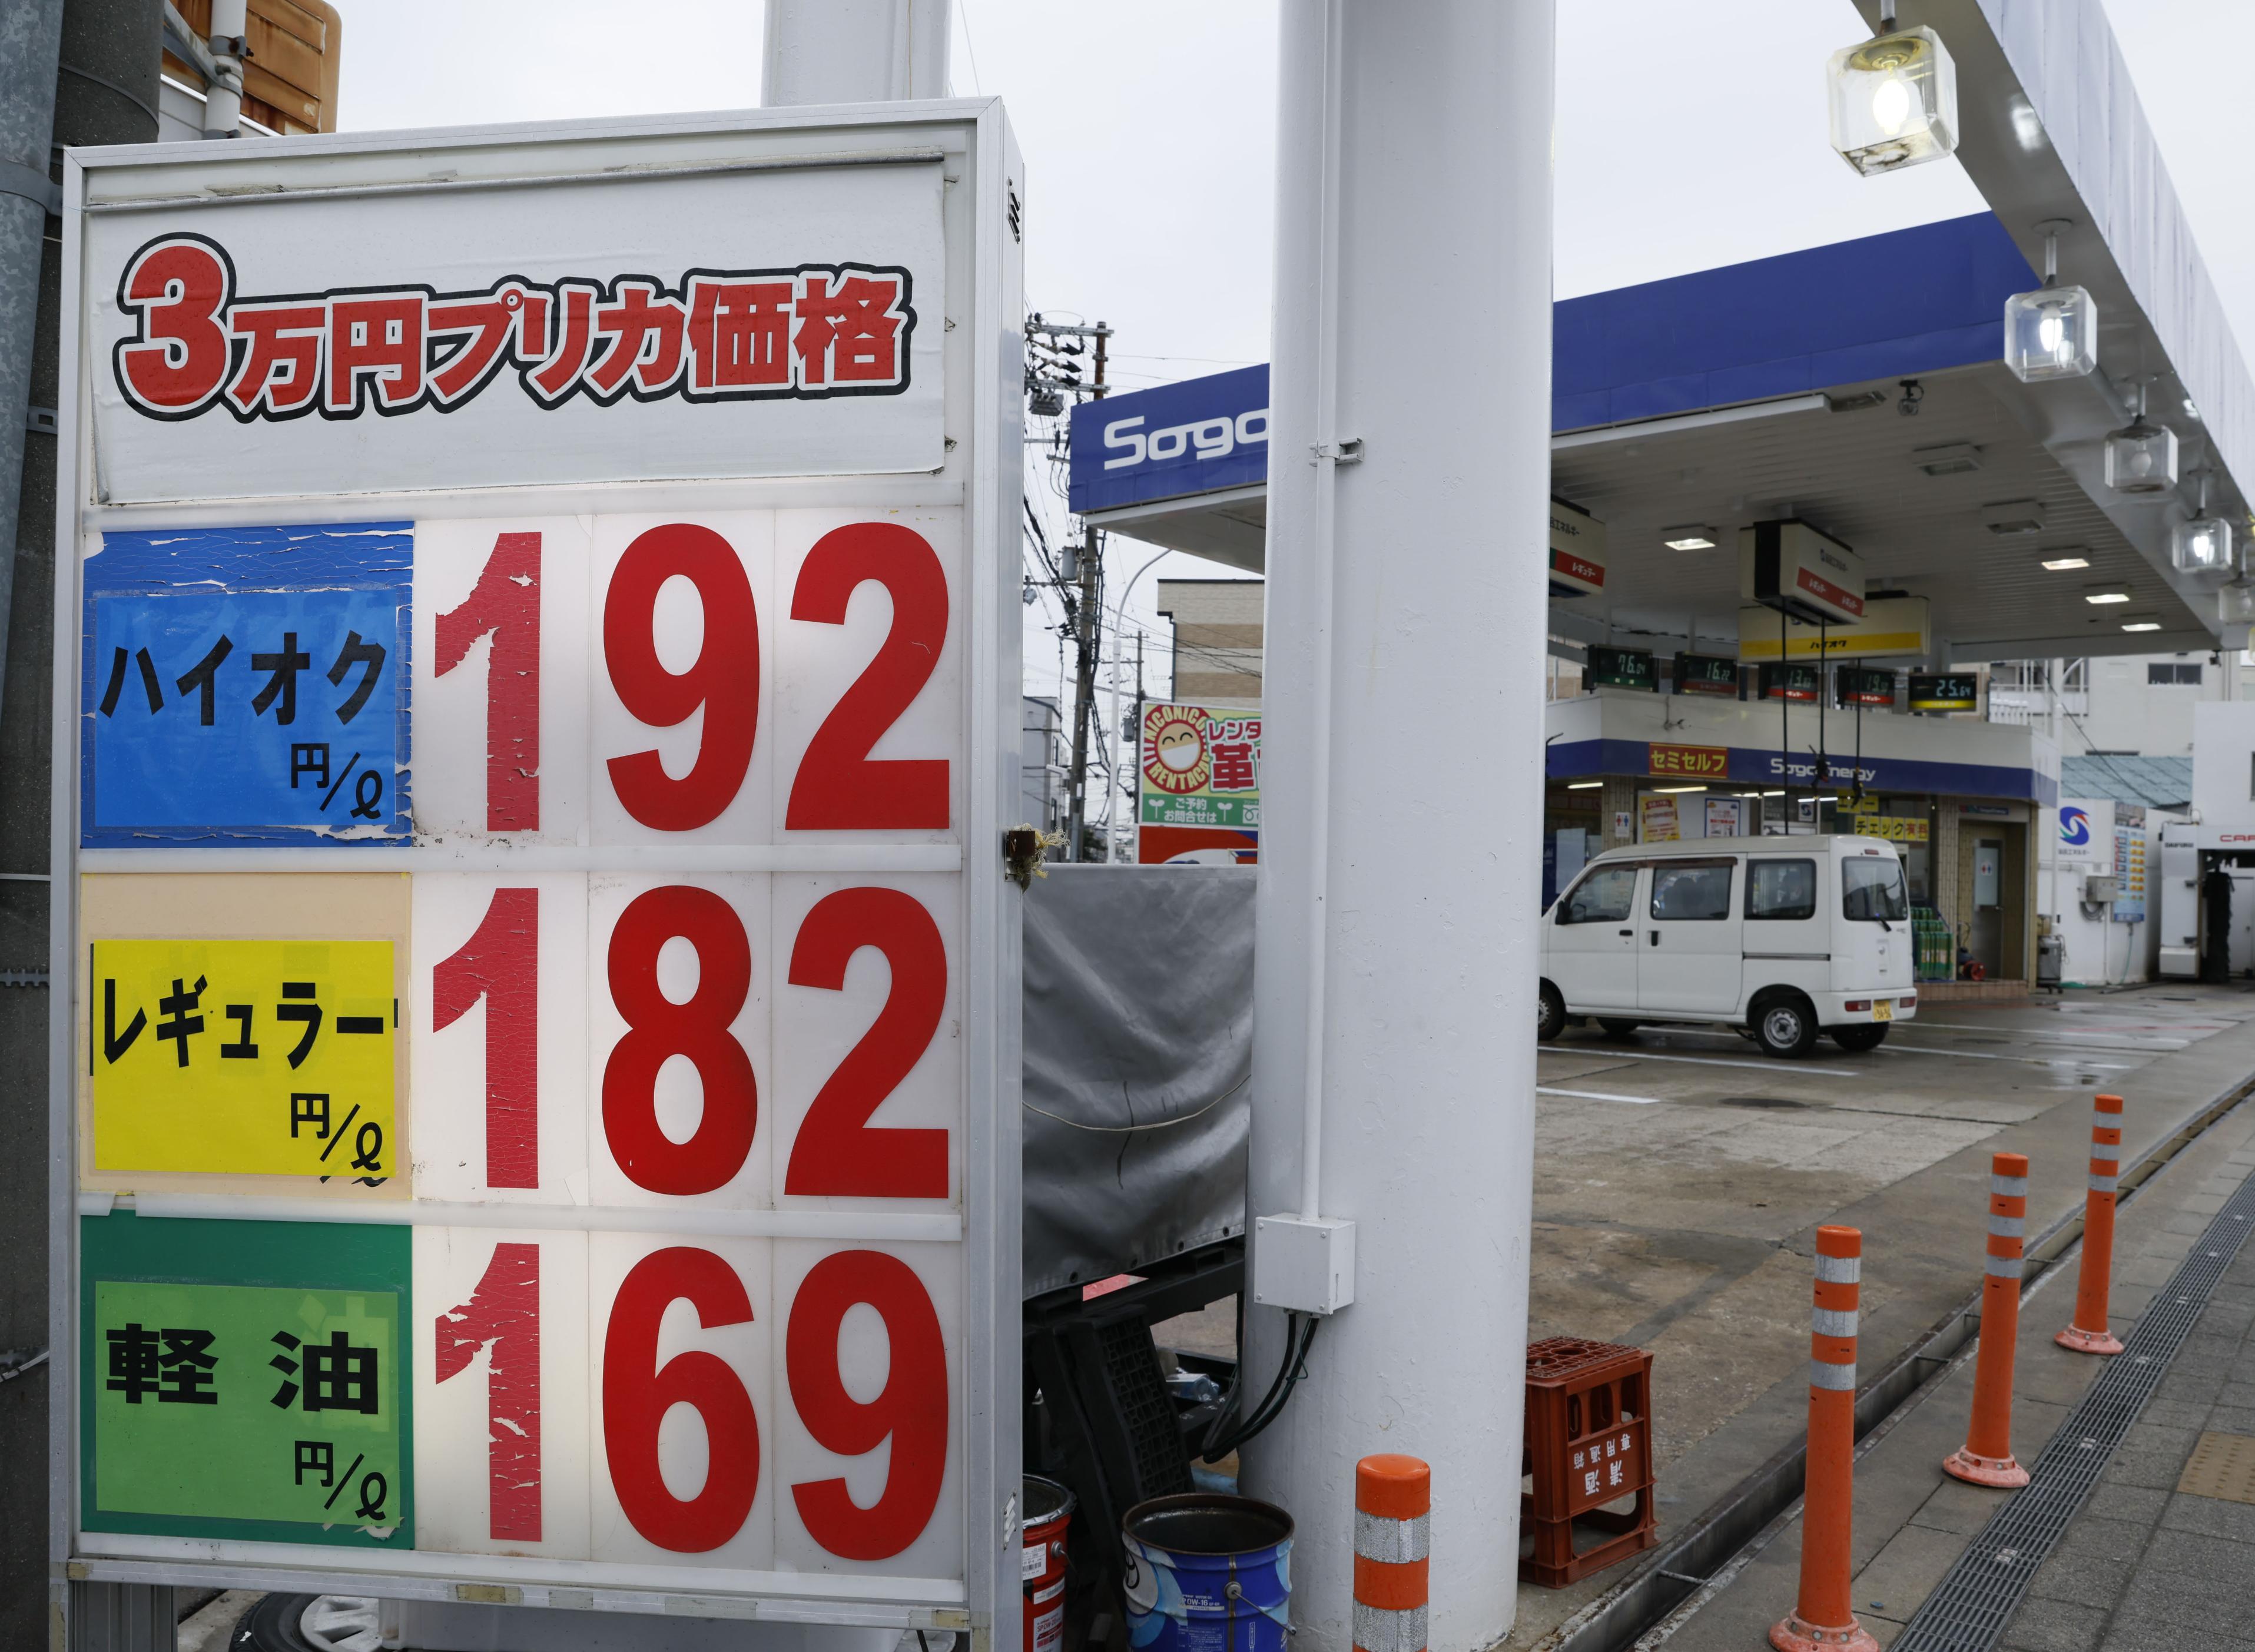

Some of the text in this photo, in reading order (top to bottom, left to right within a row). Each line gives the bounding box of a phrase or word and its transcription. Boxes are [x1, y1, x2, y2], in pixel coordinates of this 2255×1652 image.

[112, 231, 917, 422] 3万円プリカ価格
[1103, 407, 1269, 470] Sogo
[100, 630, 386, 726] ハイオク
[435, 522, 949, 832] 192
[1145, 706, 1207, 741] NICONICO
[1209, 721, 1261, 741] レンタ
[1211, 742, 1260, 788] 革
[1651, 749, 1726, 772] セミセルフ
[1164, 810, 1217, 823] お問合せは
[1175, 798, 1207, 811] ご予約
[104, 974, 383, 1070] レギュラー
[433, 885, 949, 1199] 182
[106, 1323, 378, 1415] 軽油
[435, 1242, 949, 1561] 169
[1584, 1460, 1623, 1496] 清酒
